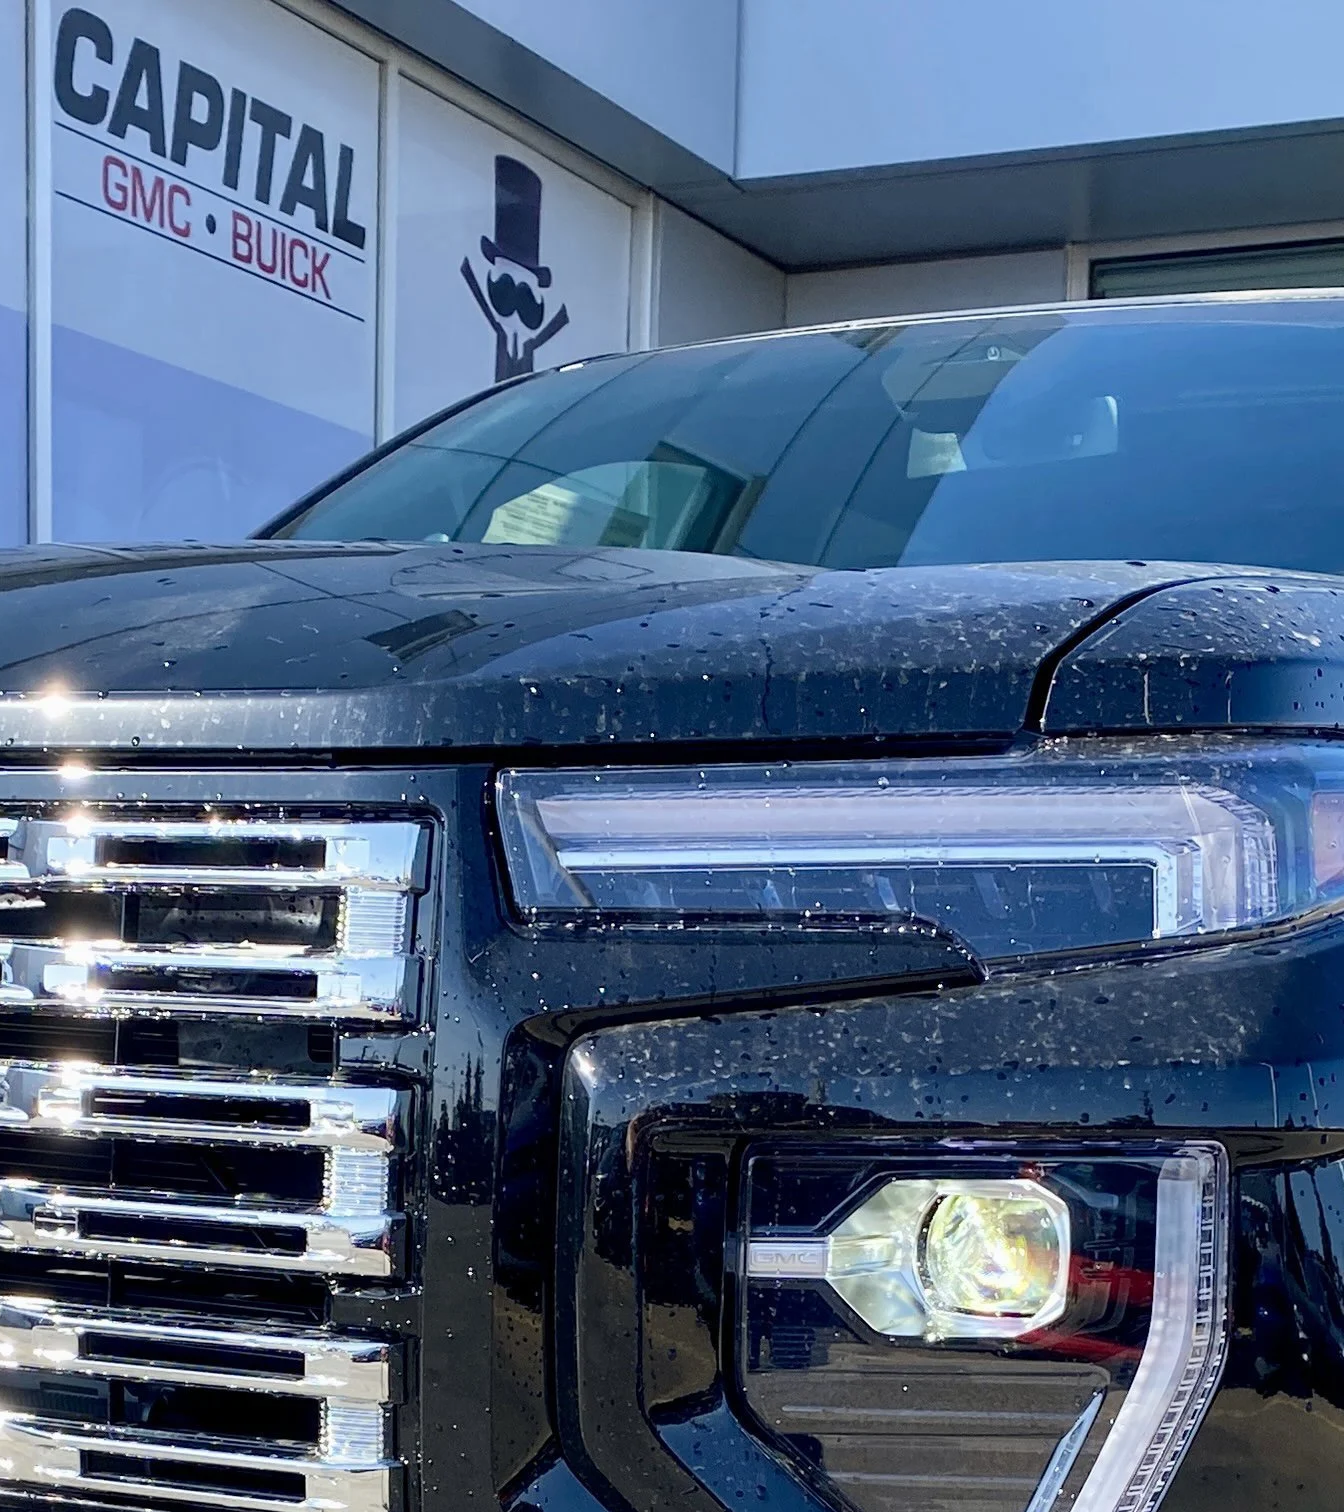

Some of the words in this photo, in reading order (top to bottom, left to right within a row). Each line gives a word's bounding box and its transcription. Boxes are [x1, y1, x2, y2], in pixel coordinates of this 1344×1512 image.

[54, 7, 366, 250] CAPITAL
[101, 155, 192, 238] GMC
[231, 209, 333, 300] BUICK
